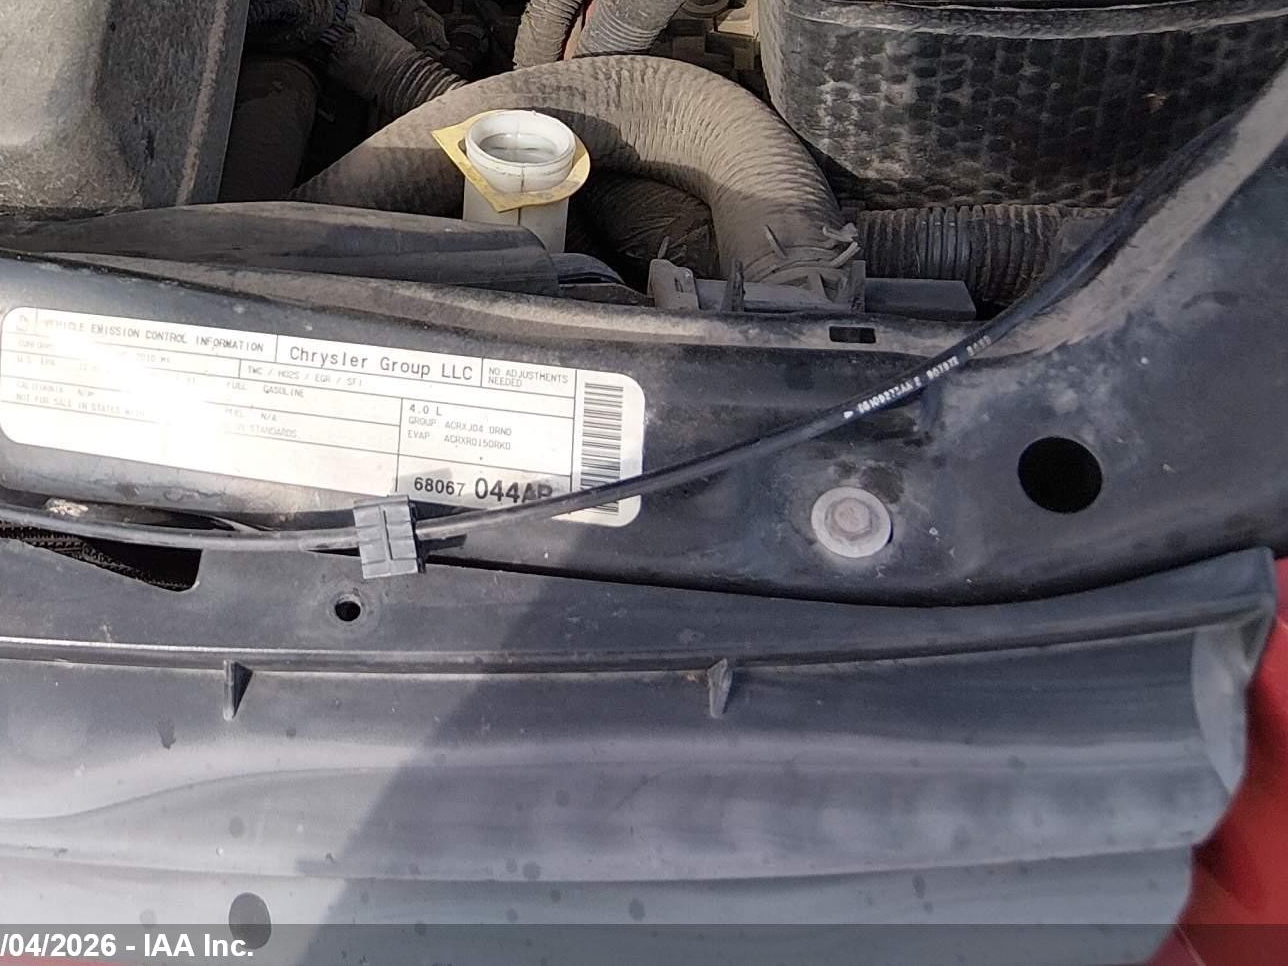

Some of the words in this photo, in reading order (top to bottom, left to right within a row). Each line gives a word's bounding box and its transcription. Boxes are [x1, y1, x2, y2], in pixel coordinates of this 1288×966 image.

[91, 323, 140, 338] EMISSION
[145, 329, 187, 344] CONTROL
[196, 336, 264, 353] INFORMATION
[289, 346, 368, 369] Chrysler
[380, 357, 431, 379] Group
[441, 363, 473, 381] LLC
[487, 376, 523, 388] NEEDED
[488, 366, 502, 377] NO
[505, 369, 569, 384] ADJUSTMENTS
[263, 384, 305, 398] GASOLINE
[409, 403, 430, 415] 4.0
[436, 405, 443, 417] L
[414, 476, 466, 497] 68067
